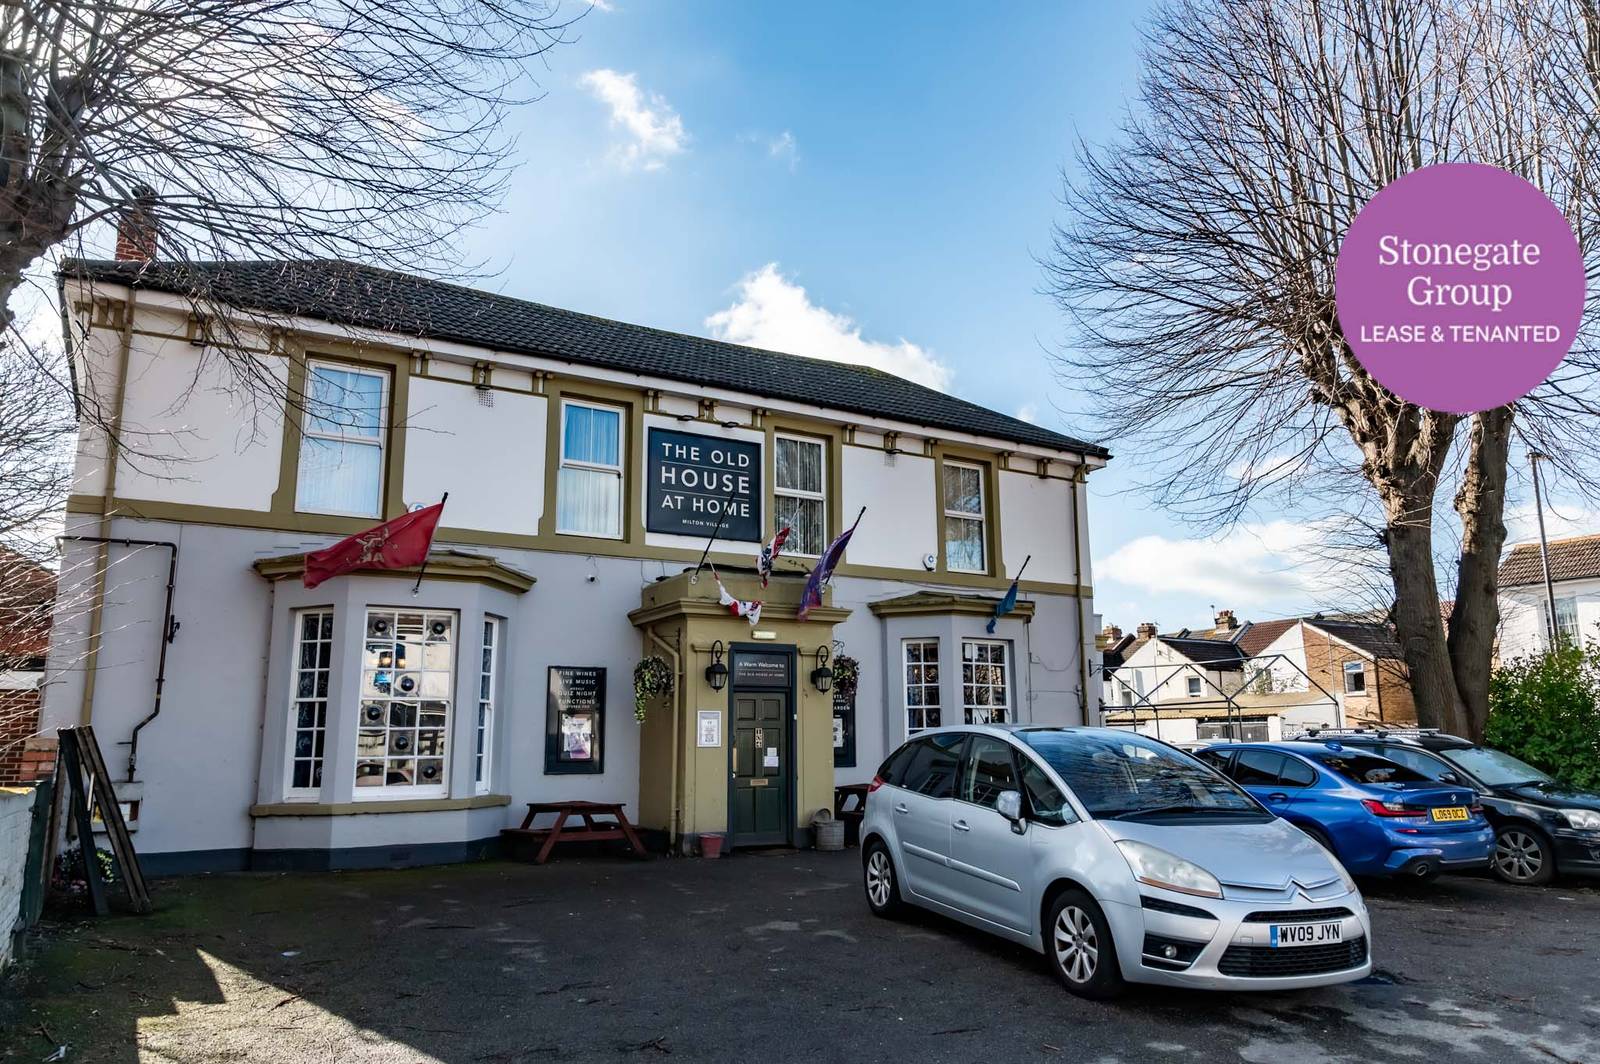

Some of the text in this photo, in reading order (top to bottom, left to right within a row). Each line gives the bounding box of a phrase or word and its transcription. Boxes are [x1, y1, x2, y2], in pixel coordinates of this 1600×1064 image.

[661, 442, 750, 467] THE OLD
[661, 466, 750, 494] HOUSE
[661, 494, 750, 518] AT HOME
[1280, 923, 1340, 943] WV09 JYN
